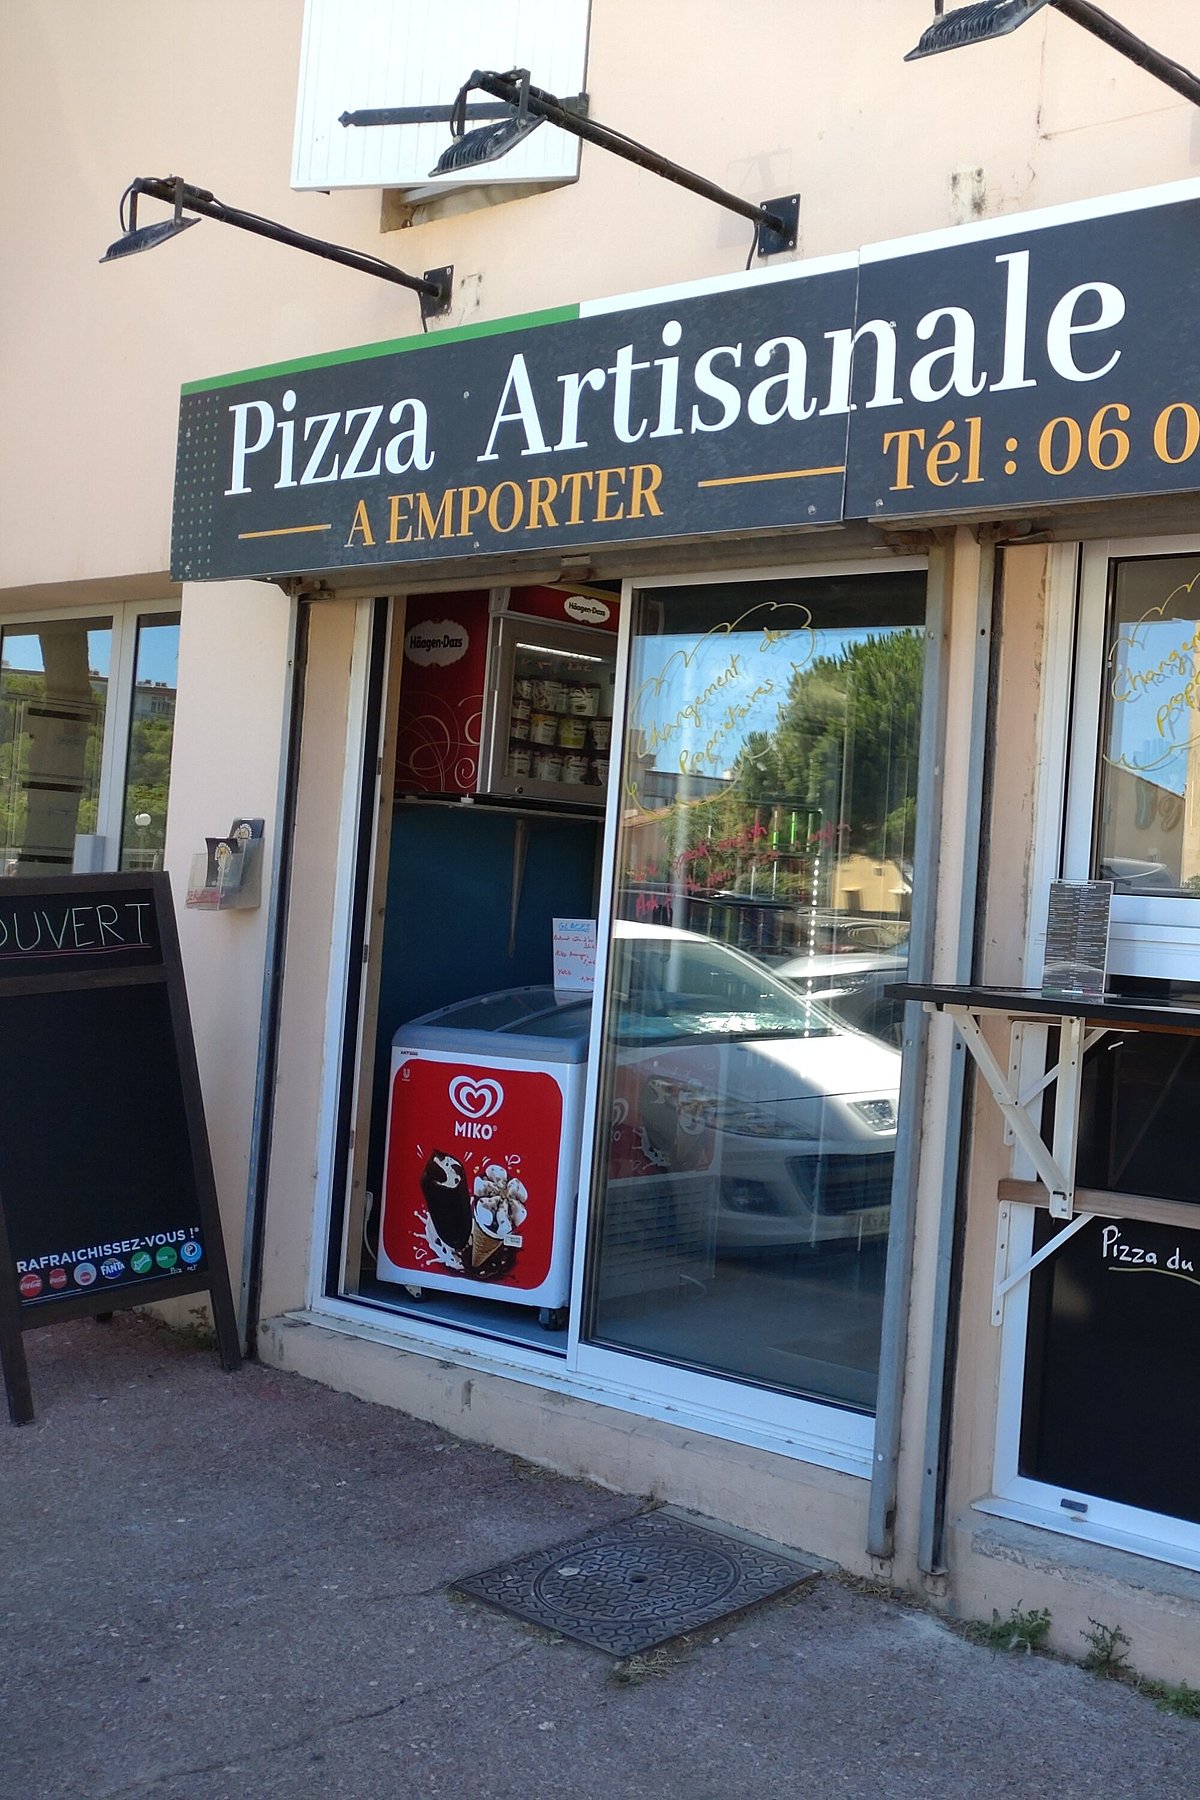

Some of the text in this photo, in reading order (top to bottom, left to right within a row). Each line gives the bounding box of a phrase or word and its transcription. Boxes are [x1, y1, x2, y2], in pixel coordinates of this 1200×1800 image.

[224, 390, 435, 496] Pizza
[477, 250, 1127, 462] Artisanale
[883, 417, 982, 491] Tél
[1039, 403, 1130, 476] 06
[344, 464, 664, 548] A EMPORTER
[410, 635, 463, 651] Häagen-Dazs
[16, 1229, 186, 1273] RAFRAICHISSEZ-VOUS
[1101, 1224, 1158, 1266] Pizza
[1166, 1247, 1194, 1273] du
